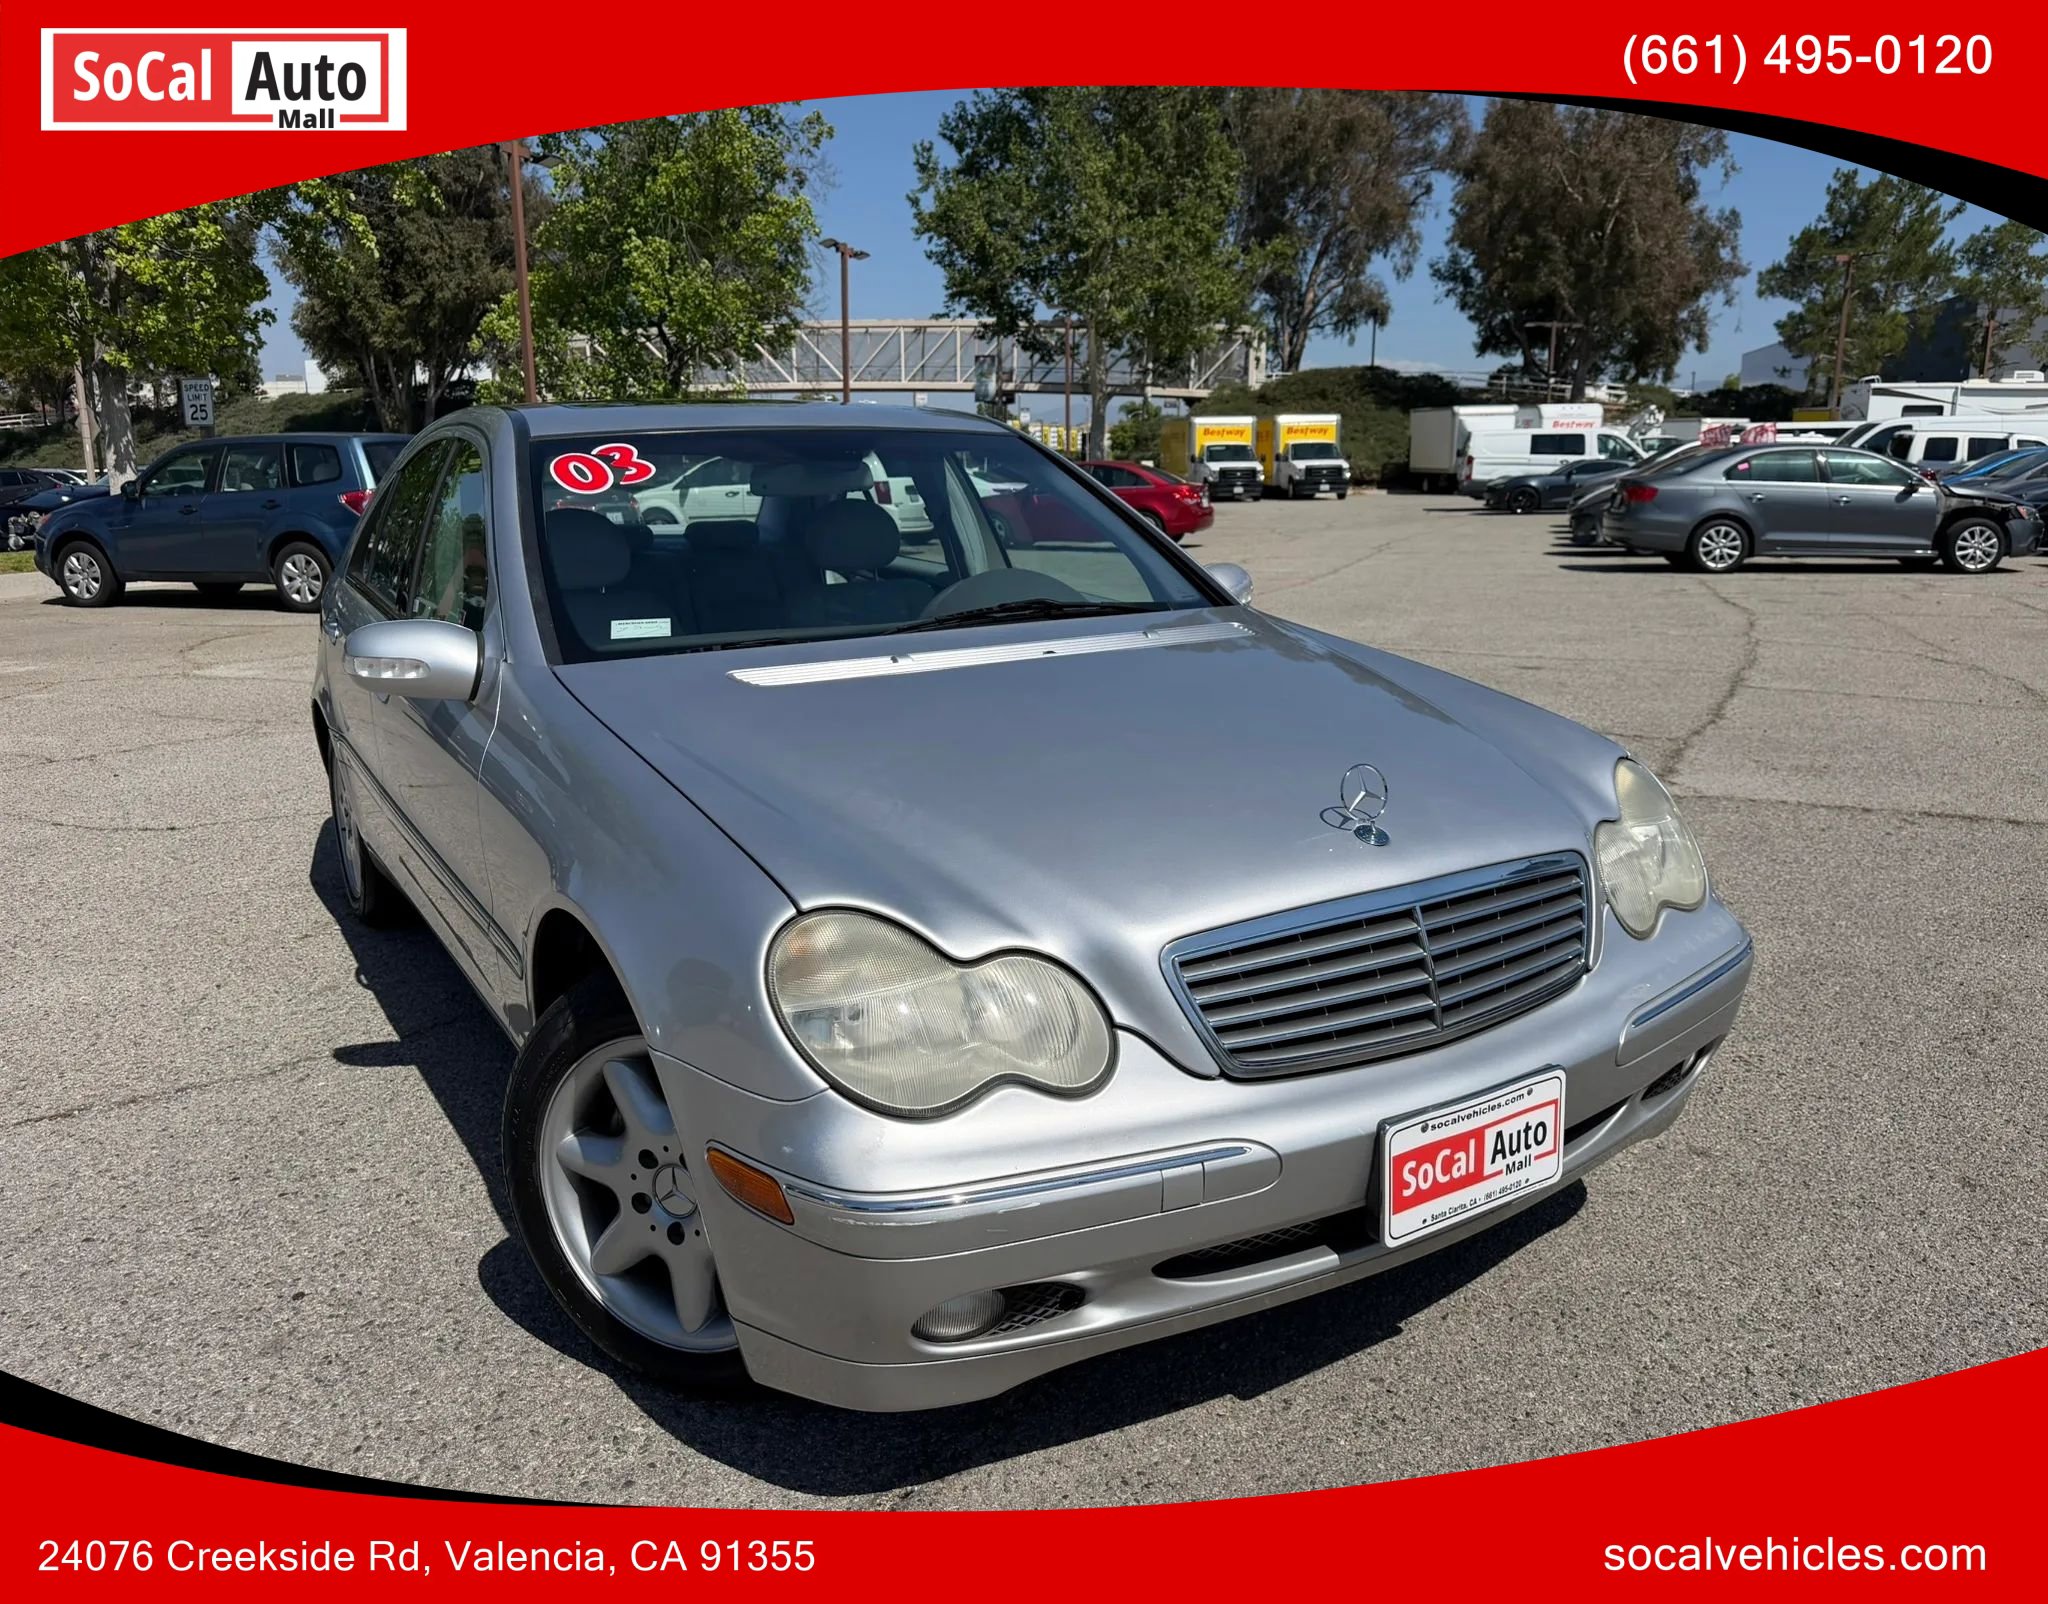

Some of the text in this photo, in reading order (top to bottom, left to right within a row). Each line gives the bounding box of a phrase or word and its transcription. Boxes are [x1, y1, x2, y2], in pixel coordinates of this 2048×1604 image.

[183, 383, 209, 392] SPEED
[187, 393, 207, 401] LIMIT
[189, 404, 209, 421] 25
[1203, 427, 1246, 438] Bestway
[1286, 426, 1329, 436] Bestway
[549, 442, 657, 495] 03
[1430, 1092, 1525, 1131] socalvehicles.com
[1402, 1120, 1547, 1197] SoCal Auto
[1505, 1153, 1532, 1176] Mall
[1430, 1208, 1447, 1222] Santa
[1469, 1197, 1478, 1207] CA
[1483, 1189, 1498, 1201] (661)
